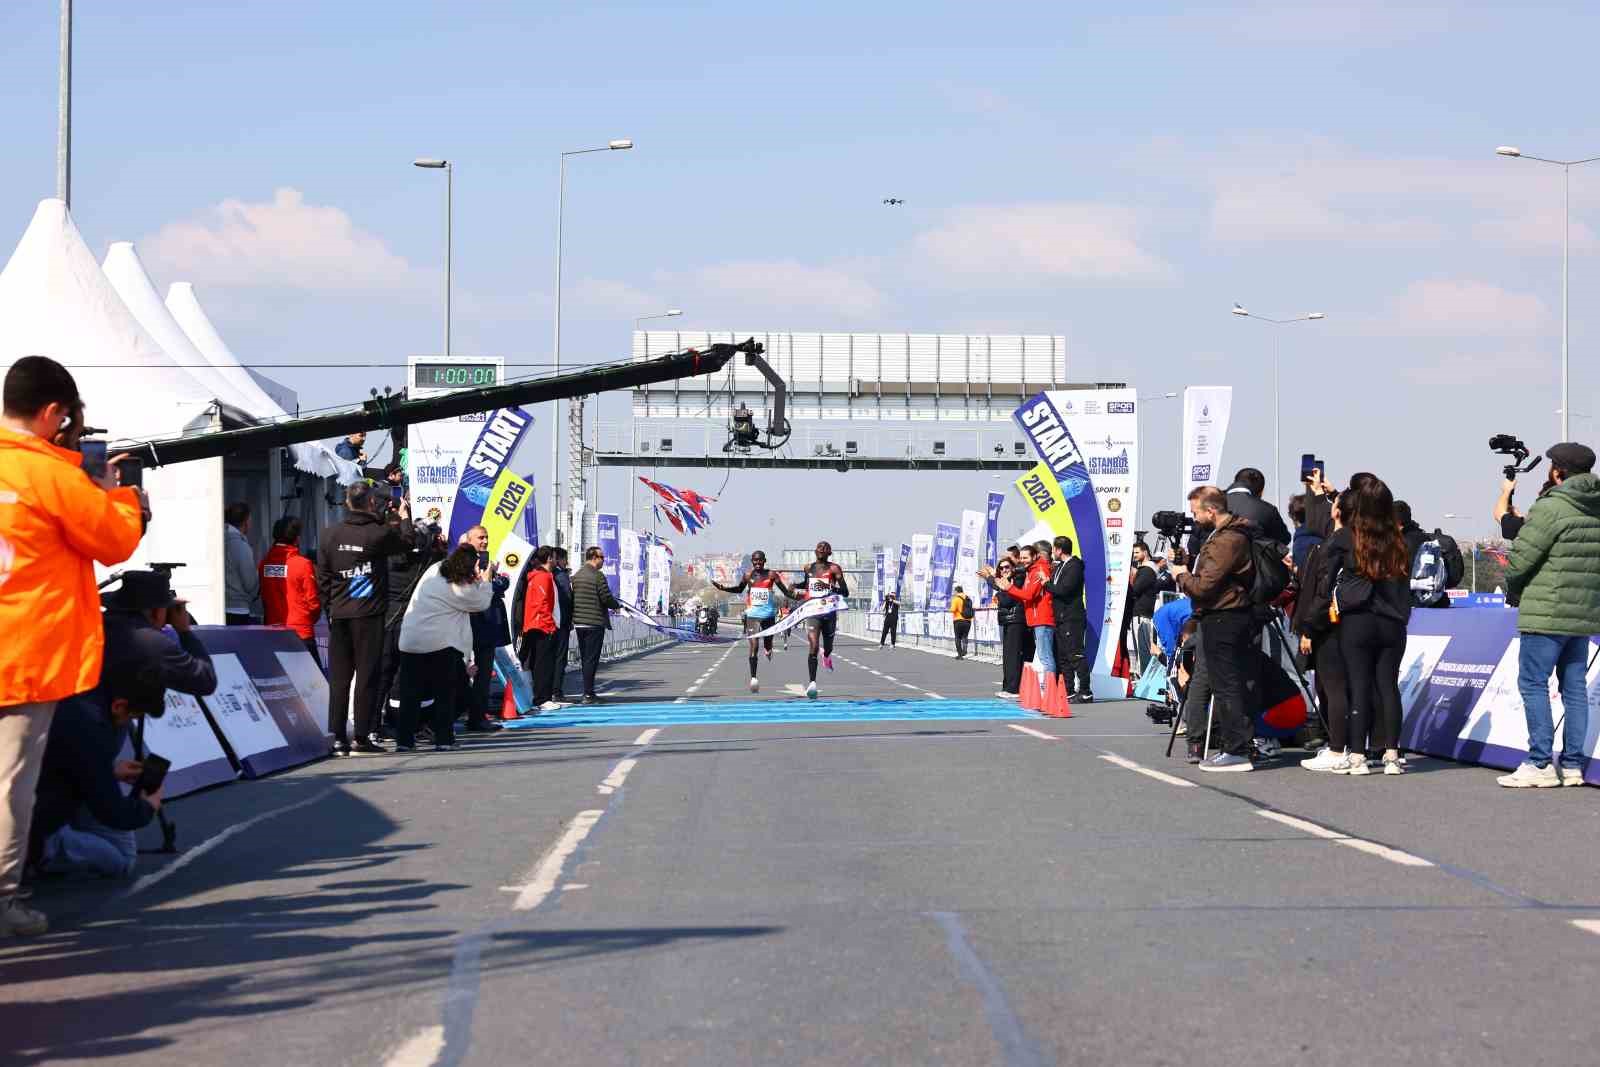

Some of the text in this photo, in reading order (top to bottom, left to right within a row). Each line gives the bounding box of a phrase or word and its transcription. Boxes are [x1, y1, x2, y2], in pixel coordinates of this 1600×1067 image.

[434, 368, 495, 384] 1:00:00
[468, 407, 526, 478] START
[1021, 402, 1081, 472] START
[494, 481, 527, 521] 2026
[1022, 474, 1057, 513] 2026
[1095, 486, 1130, 494] SPORTIE
[339, 561, 372, 579] TEAM
